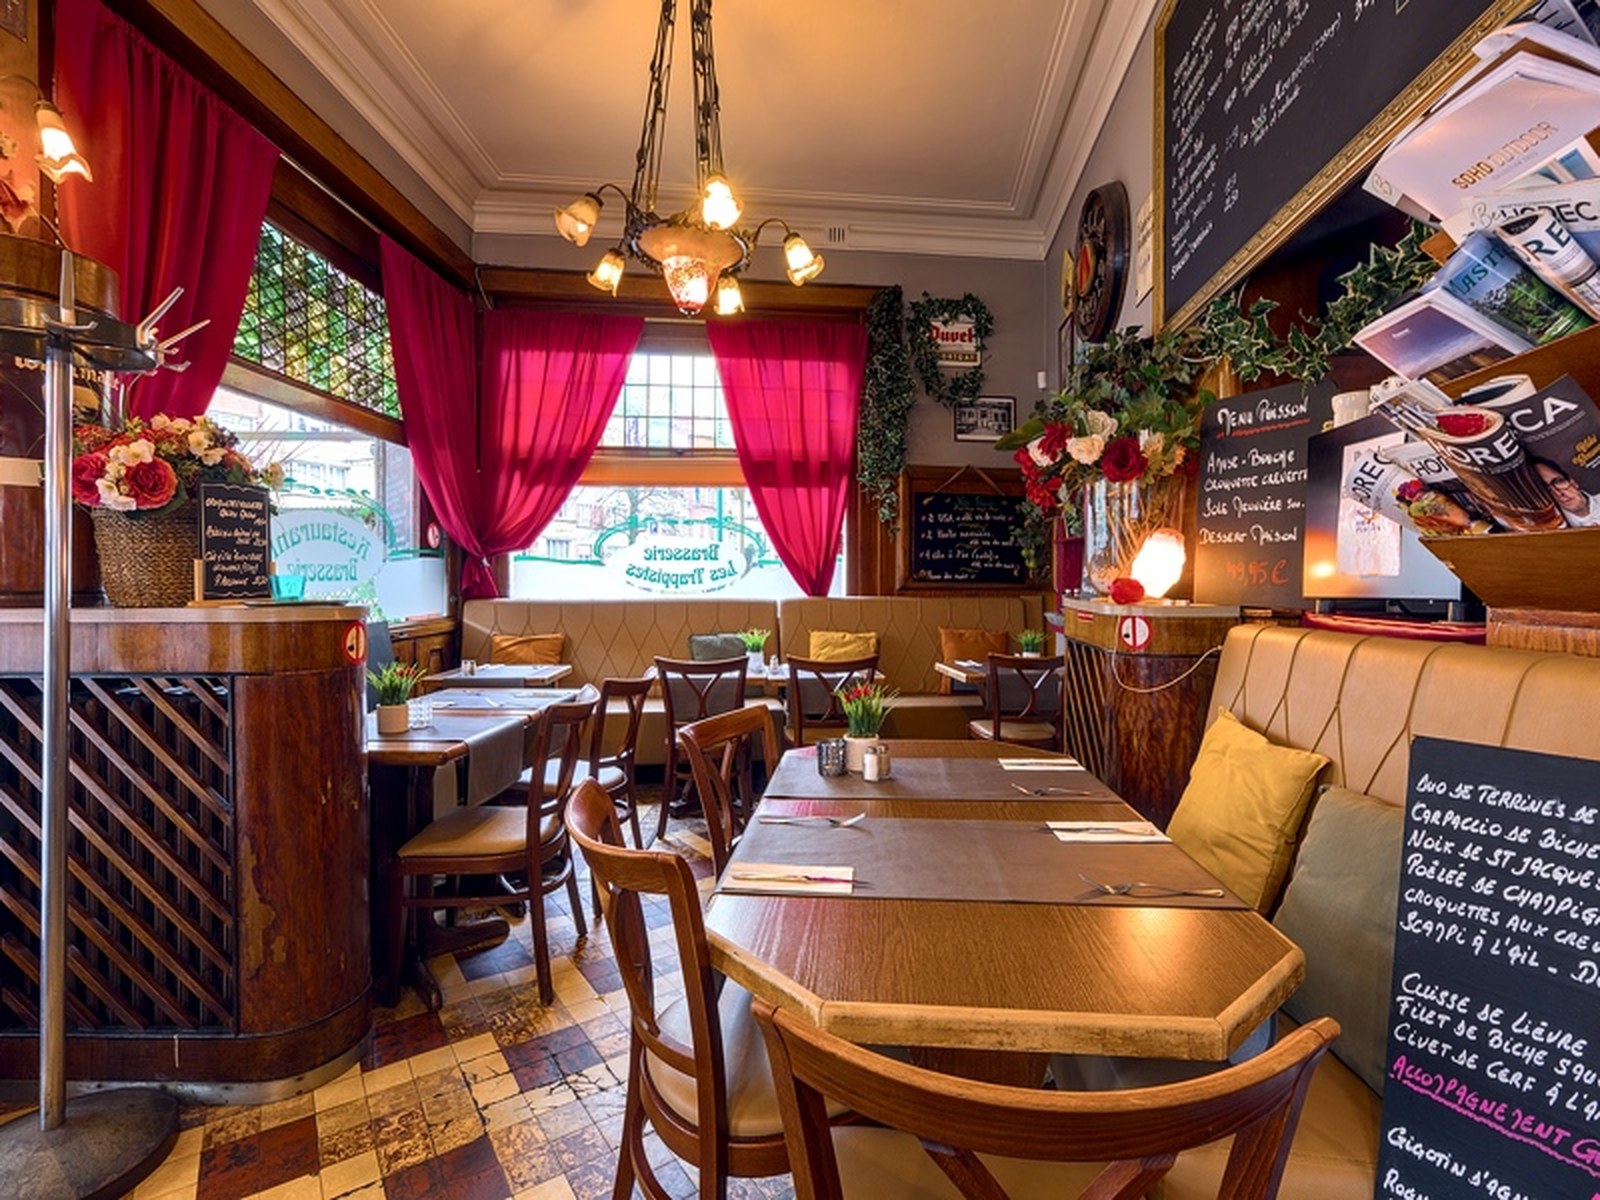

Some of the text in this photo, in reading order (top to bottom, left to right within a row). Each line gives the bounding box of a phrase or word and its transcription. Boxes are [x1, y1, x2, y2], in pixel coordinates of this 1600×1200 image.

[1452, 161, 1494, 189] SOHO
[1488, 121, 1559, 166] OUTDOOR
[929, 325, 973, 343] Duvel
[1570, 959, 1600, 989] D
